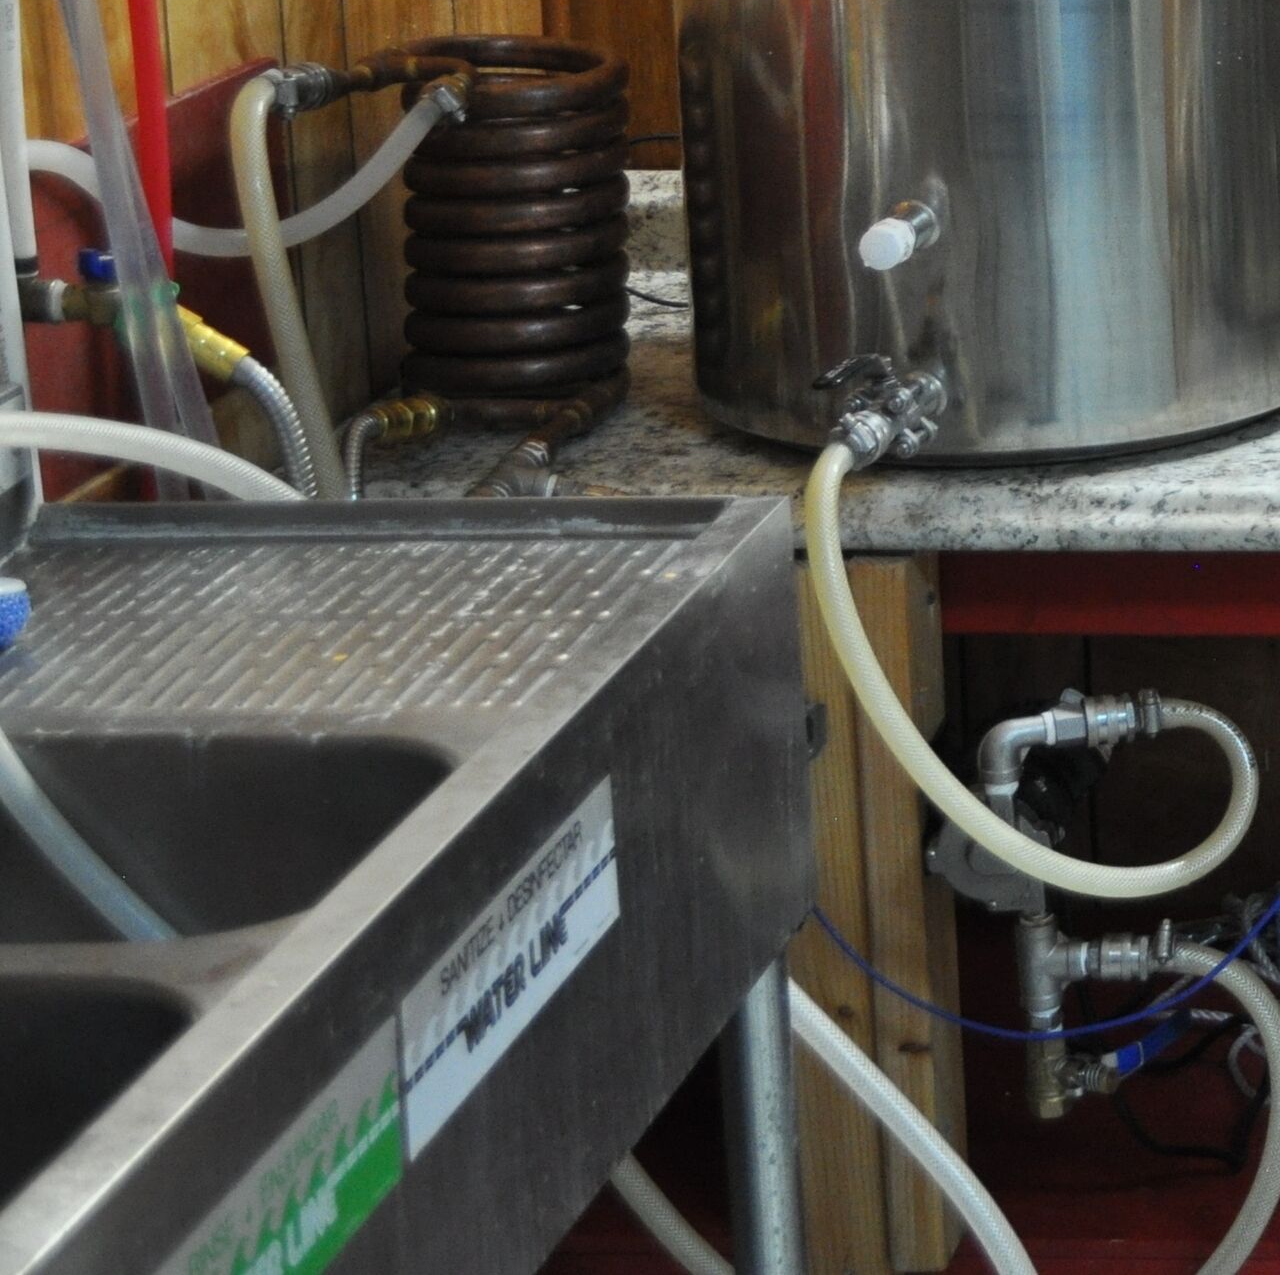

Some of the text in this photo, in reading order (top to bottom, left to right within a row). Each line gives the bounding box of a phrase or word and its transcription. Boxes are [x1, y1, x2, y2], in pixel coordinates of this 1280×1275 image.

[439, 915, 494, 996] SANITIZE
[462, 912, 568, 1054] WATER LINE
